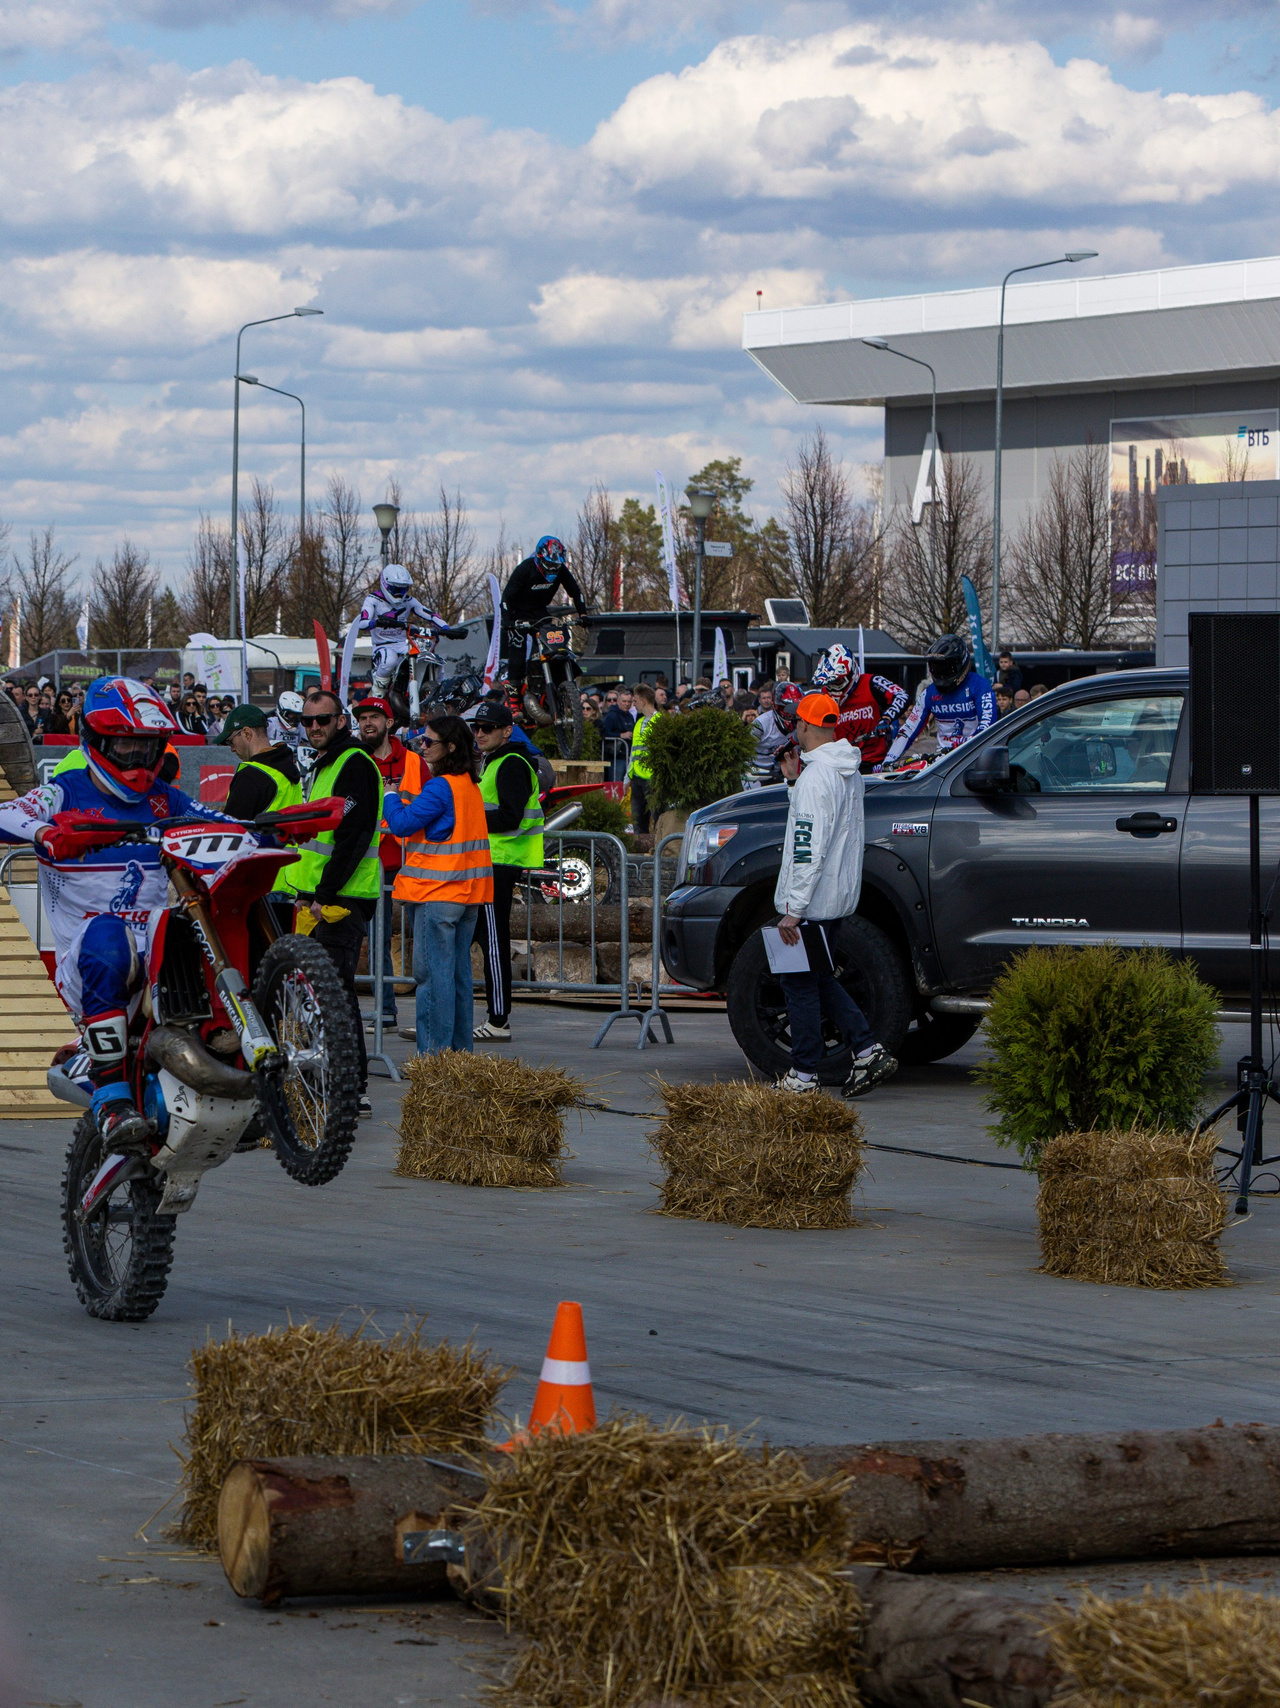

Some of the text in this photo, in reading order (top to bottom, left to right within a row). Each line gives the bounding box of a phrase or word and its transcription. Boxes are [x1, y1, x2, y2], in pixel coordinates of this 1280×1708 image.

[1248, 428, 1270, 447] ВТБ
[419, 626, 432, 637] 24
[546, 630, 565, 645] 95
[914, 825, 927, 834] V8
[181, 833, 244, 857] 777
[793, 820, 814, 864] FCLM
[1011, 917, 1091, 928] TUNDRA
[241, 1000, 264, 1037] Husqvarna
